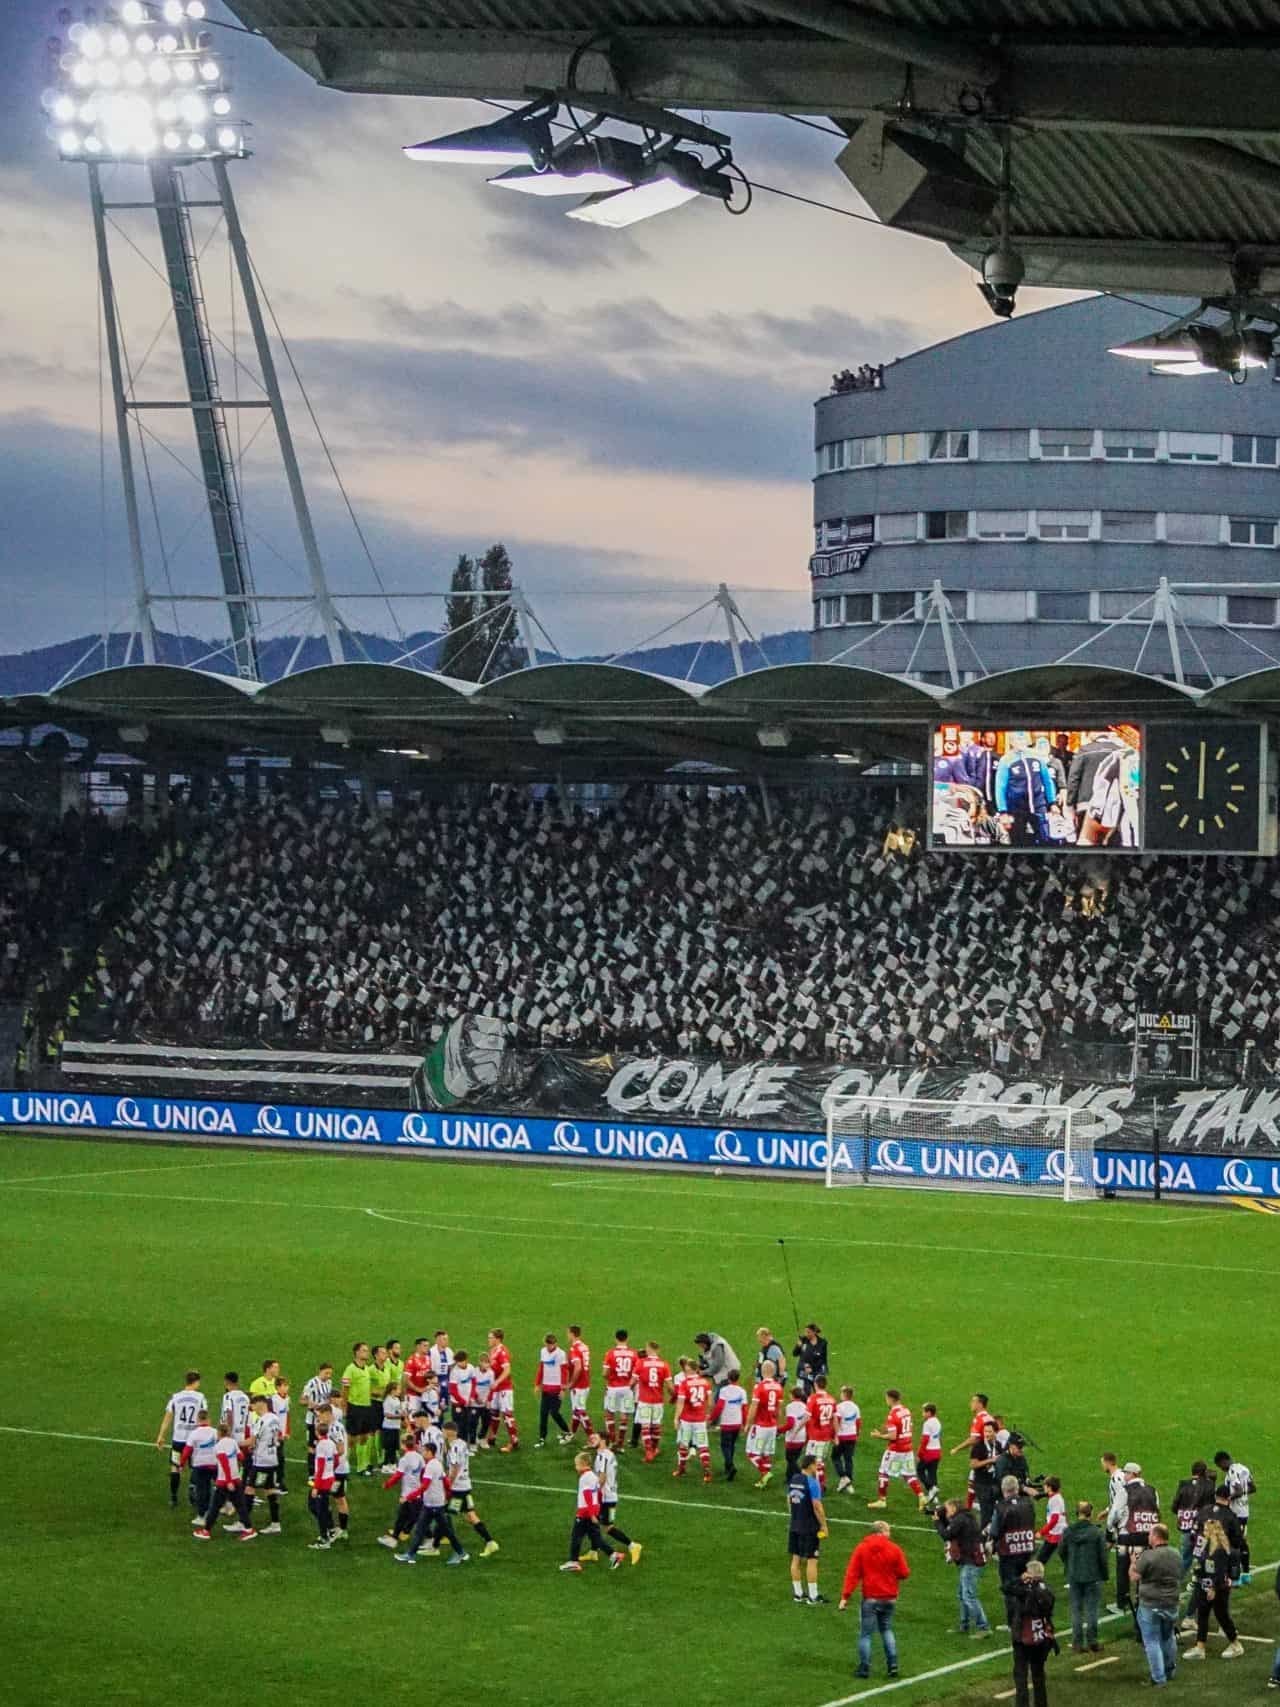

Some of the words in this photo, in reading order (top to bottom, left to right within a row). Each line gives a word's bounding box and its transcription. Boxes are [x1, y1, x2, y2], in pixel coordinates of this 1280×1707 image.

[603, 1056, 799, 1118] COME
[821, 1068, 929, 1124] ON
[12, 1098, 96, 1124] UNIQA
[153, 1104, 237, 1133] UNIQA
[295, 1112, 381, 1141] UNIQA
[441, 1119, 531, 1150] UNIQA
[594, 1128, 689, 1159] UNIQA
[757, 1137, 853, 1169] UNIQA
[921, 1146, 1020, 1179] UNIQA
[1092, 1157, 1196, 1190] UNIQA
[615, 1357, 632, 1373] 30
[689, 1386, 705, 1404] 24
[180, 1405, 196, 1424] 42
[1177, 1510, 1199, 1519] FOT
[1005, 1530, 1034, 1543] FOTO
